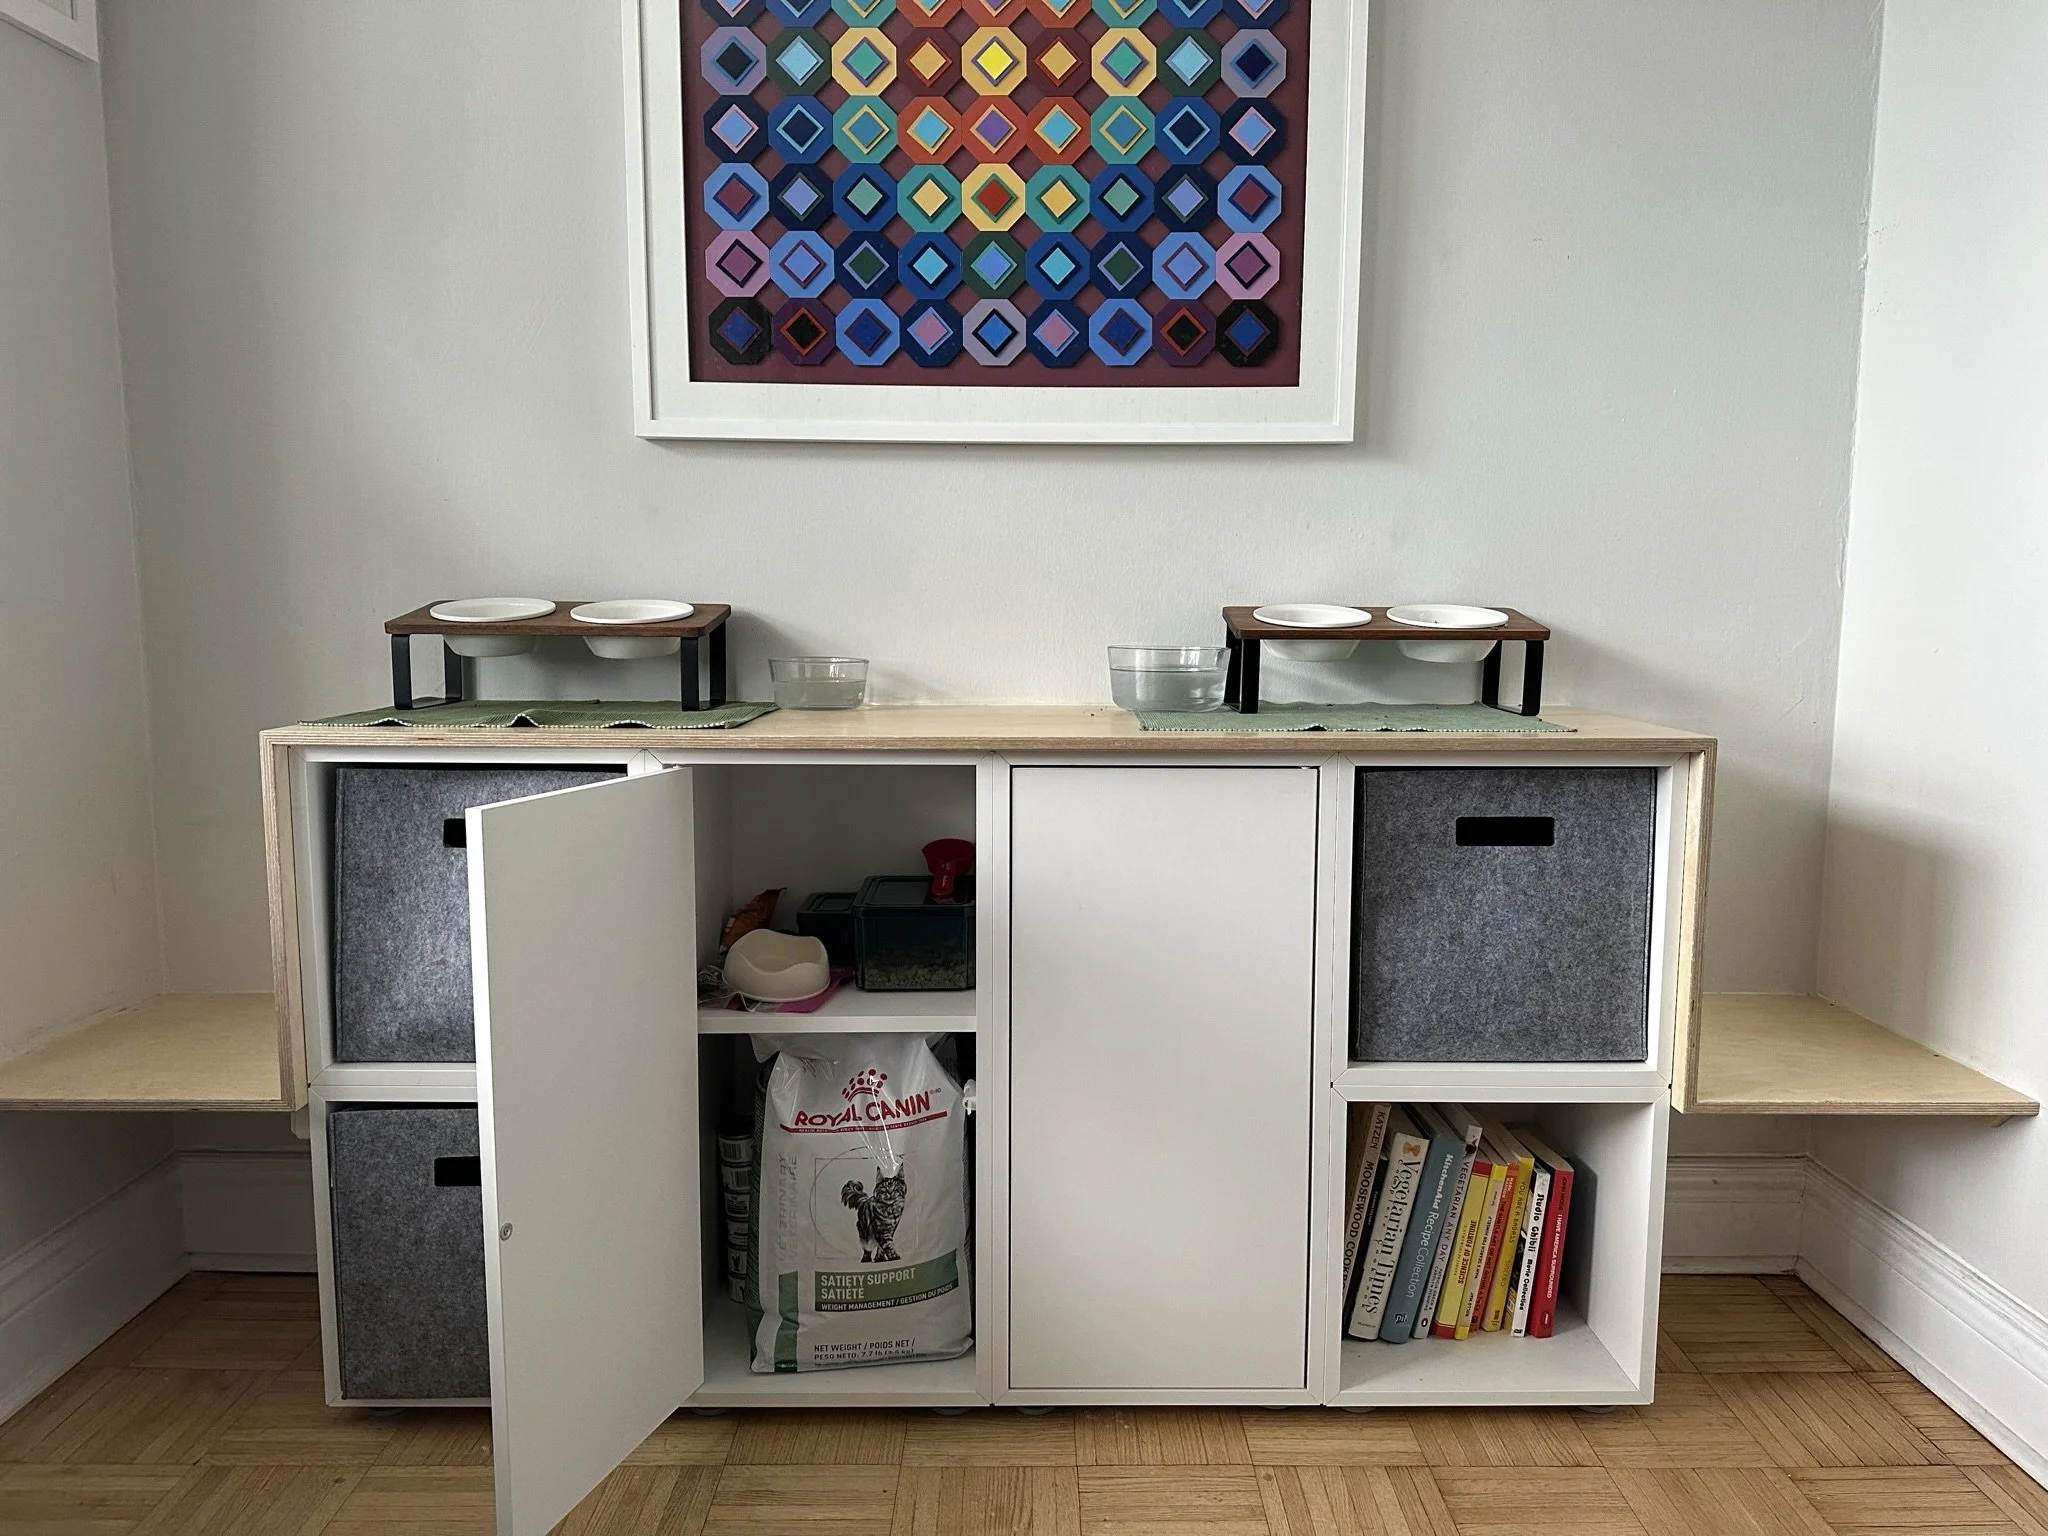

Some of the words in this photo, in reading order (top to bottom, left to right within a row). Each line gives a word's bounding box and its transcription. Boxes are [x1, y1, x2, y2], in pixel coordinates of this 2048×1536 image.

[794, 1103, 863, 1127] ROYAL
[865, 1090, 930, 1122] CANIN
[1370, 1111, 1385, 1149] KATZEN
[1432, 1153, 1454, 1209] KitchenAid
[1449, 1161, 1470, 1219] VEGETARIAN
[1519, 1181, 1527, 1195] YOU
[1350, 1160, 1374, 1238] MOOSEWOOD
[1381, 1159, 1420, 1255] Vegetarian
[1533, 1193, 1545, 1221] Studio
[1420, 1211, 1440, 1247] Recipe
[1445, 1221, 1454, 1241] ANY
[1466, 1220, 1477, 1248] FORTUNE
[1495, 1212, 1503, 1233] SUBTLE
[1509, 1218, 1518, 1243] BADASS
[1438, 1244, 1449, 1262] DAY
[1464, 1249, 1471, 1257] OF
[1477, 1246, 1485, 1264] SEARCH
[1484, 1216, 1492, 1235] HIMSELF
[1528, 1226, 1540, 1252] Ghibli
[1552, 1233, 1560, 1258] AMERICA
[821, 1275, 864, 1287] SATIETY
[867, 1268, 916, 1286] SUPPORT
[1406, 1247, 1429, 1298] Collection
[1458, 1258, 1469, 1284] SCIENCE
[1501, 1259, 1511, 1287] SINCERO
[1524, 1259, 1533, 1277] Movie
[1547, 1259, 1556, 1298] SURROUNDED
[821, 1303, 847, 1311] WEIGHT
[849, 1300, 895, 1310] MANAGEMENT
[900, 1293, 927, 1304] GESTION
[928, 1290, 936, 1298] DU
[936, 1284, 953, 1296] POIDS
[1366, 1260, 1396, 1314] Times
[1519, 1279, 1530, 1310] Collection
[814, 1344, 829, 1352] NET
[831, 1343, 862, 1352] WEIGHT
[869, 1341, 893, 1349] POIDS
[895, 1339, 910, 1348] NET
